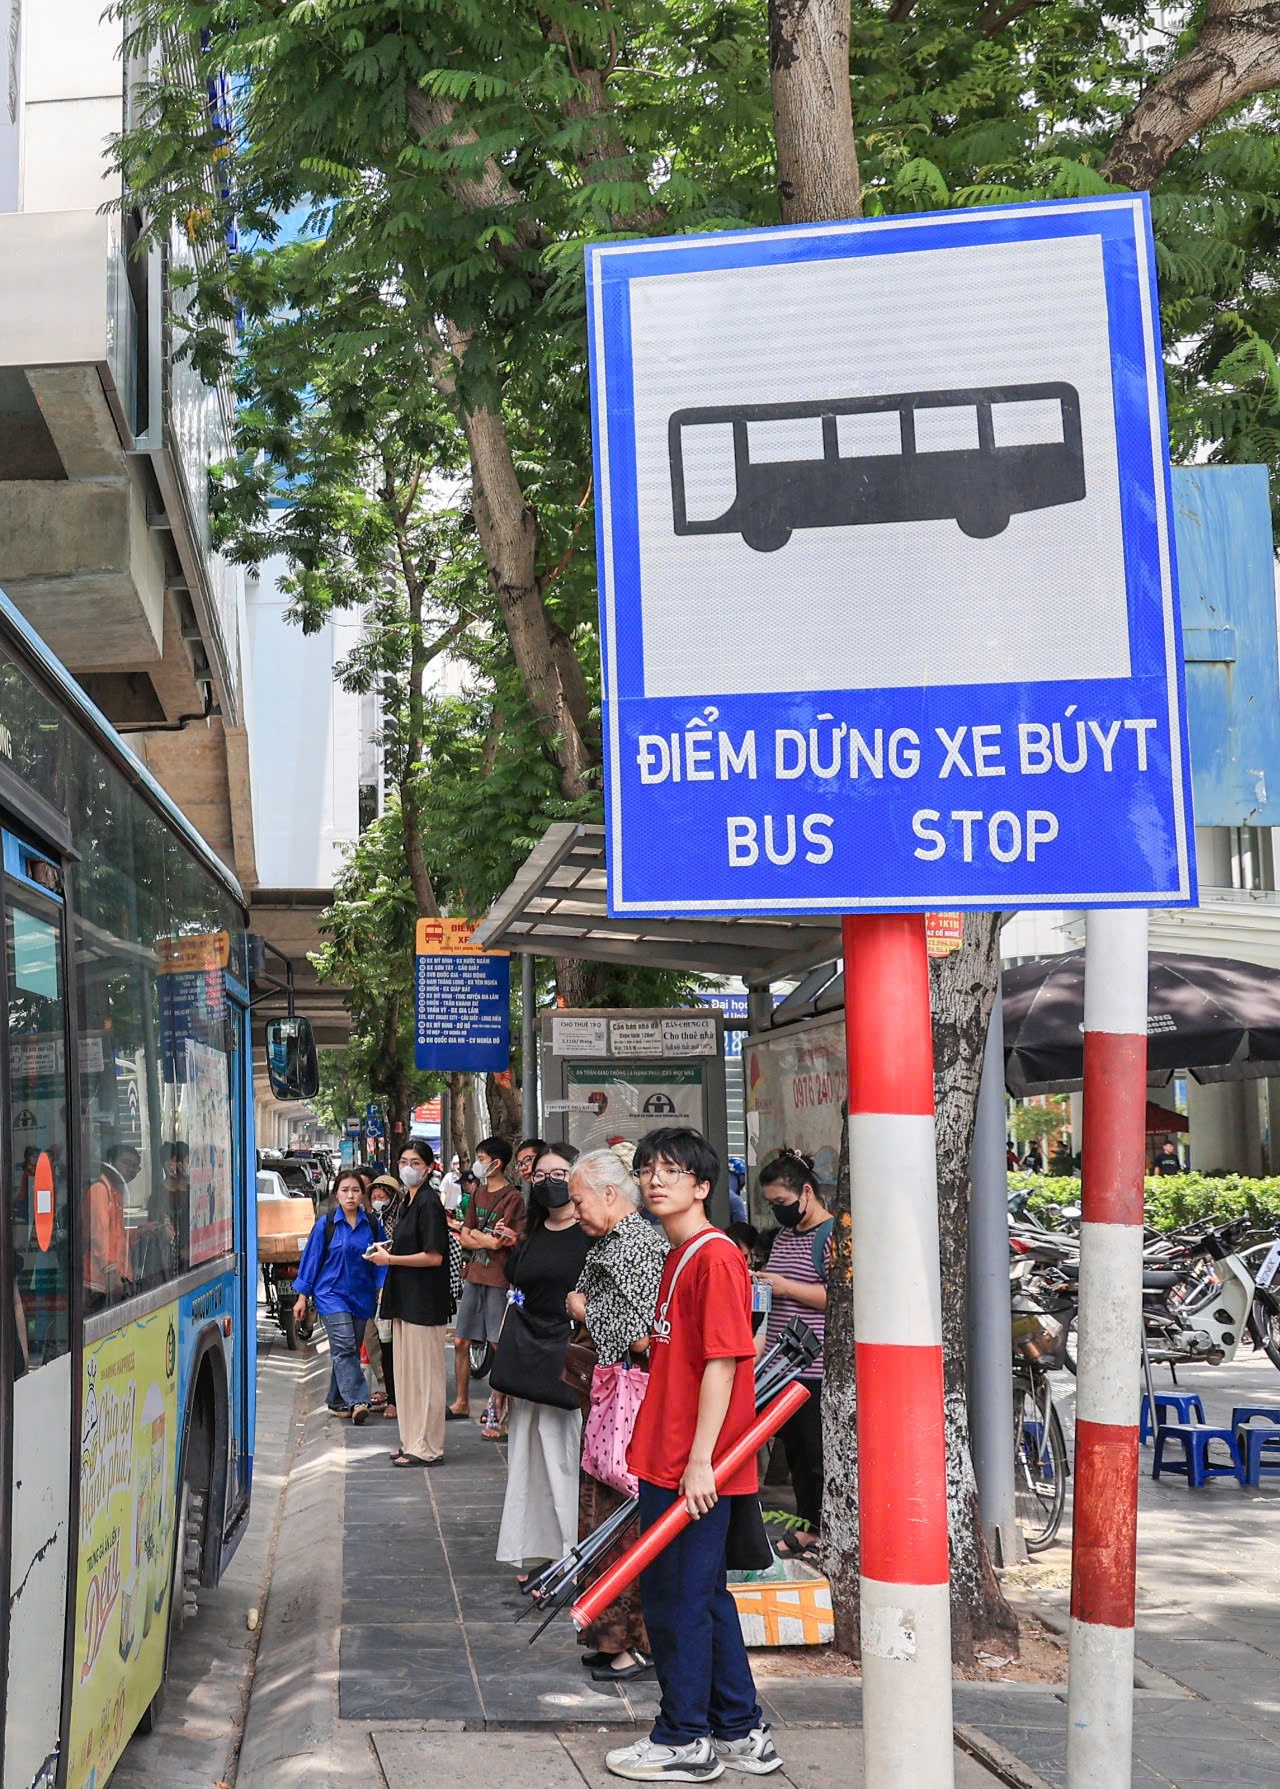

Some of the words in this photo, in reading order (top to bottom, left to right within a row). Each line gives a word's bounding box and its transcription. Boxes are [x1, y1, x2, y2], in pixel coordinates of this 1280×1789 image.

[636, 706, 758, 785] ĐIỂM
[775, 713, 920, 780] DỪNG
[938, 725, 1006, 778] XE
[1020, 705, 1158, 775] BÚYT
[726, 814, 835, 868] BUS
[912, 809, 1060, 862] STOP
[663, 1031, 679, 1040] Cho
[681, 1030, 698, 1040] thuê
[371, 1105, 378, 1113] P
